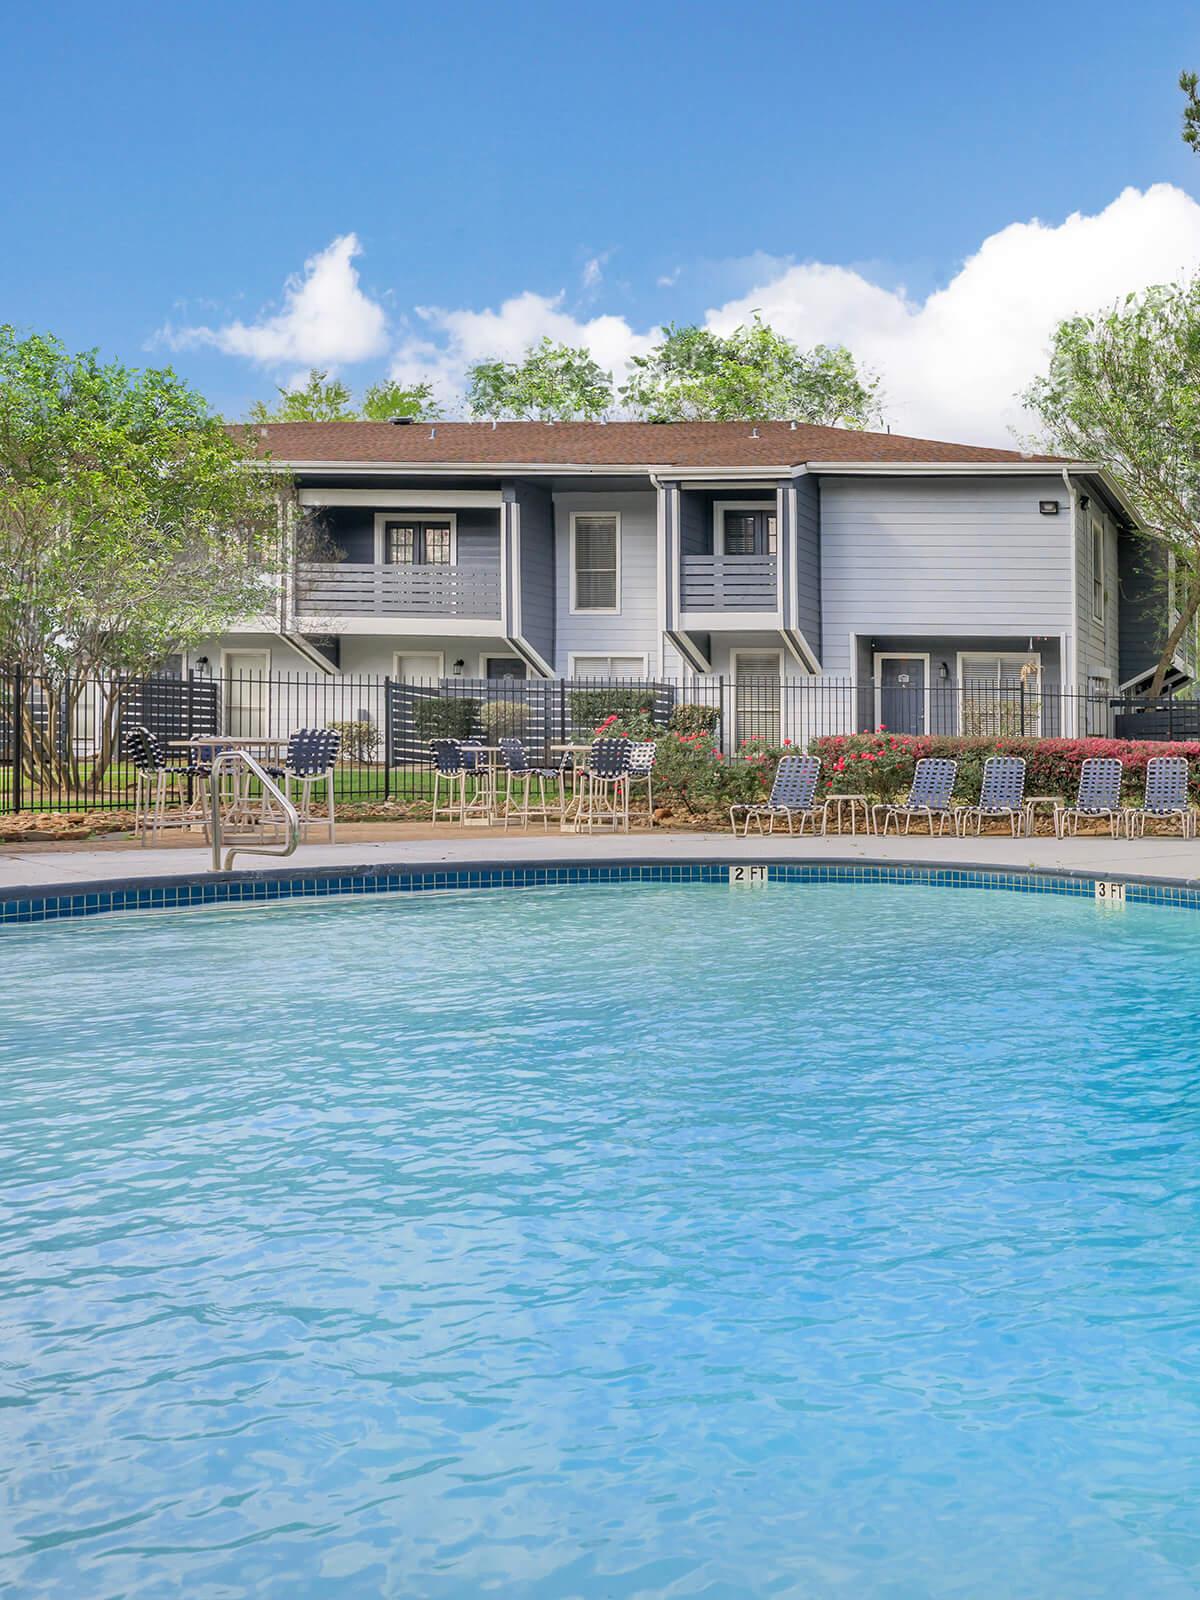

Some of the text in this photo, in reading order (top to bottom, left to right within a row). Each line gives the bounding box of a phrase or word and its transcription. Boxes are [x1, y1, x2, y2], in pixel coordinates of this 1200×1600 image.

[735, 866, 766, 880] 2 FT
[1099, 882, 1123, 899] 3 FT
